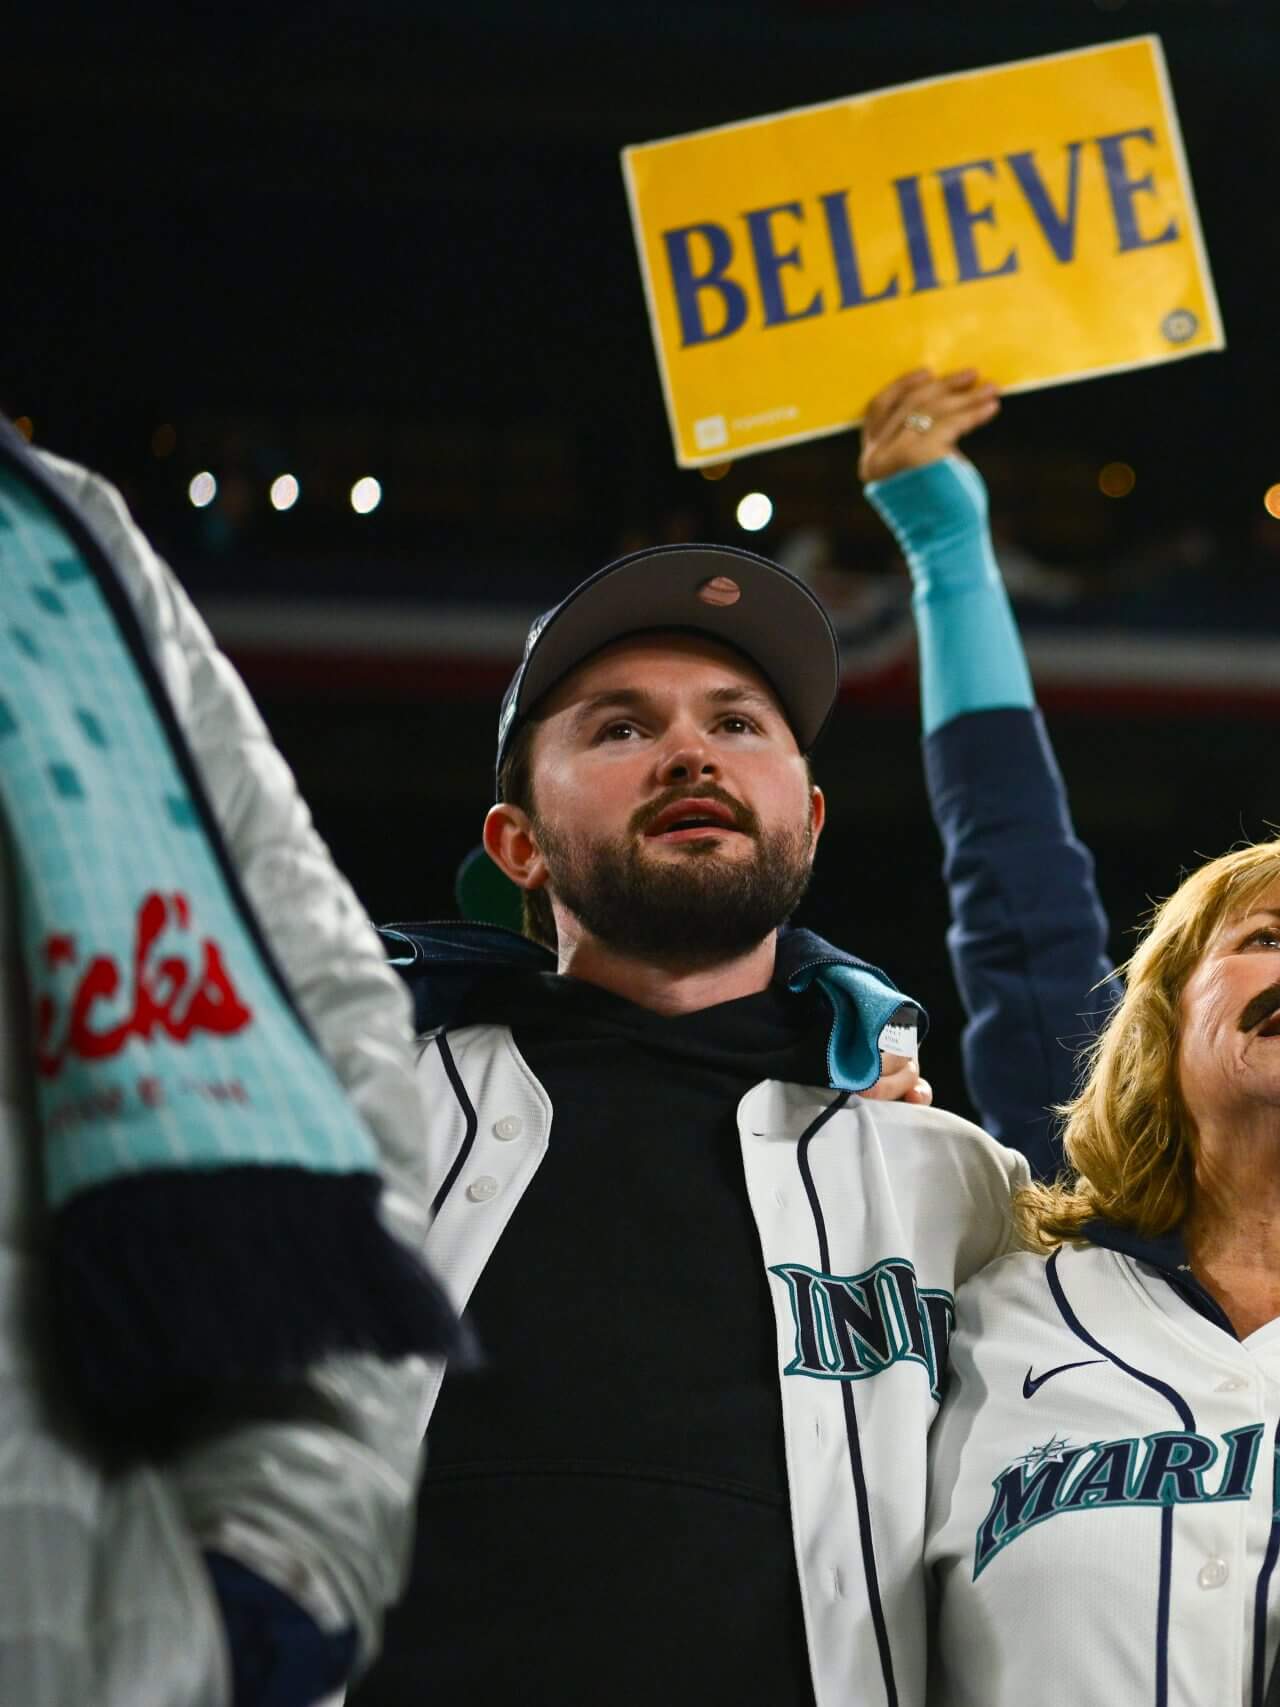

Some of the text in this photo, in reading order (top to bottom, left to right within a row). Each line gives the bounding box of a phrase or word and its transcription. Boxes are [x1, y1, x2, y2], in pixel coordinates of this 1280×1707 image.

[661, 126, 1180, 350] BELIEVE
[38, 889, 254, 1080] ick's
[768, 1256, 956, 1403] IN
